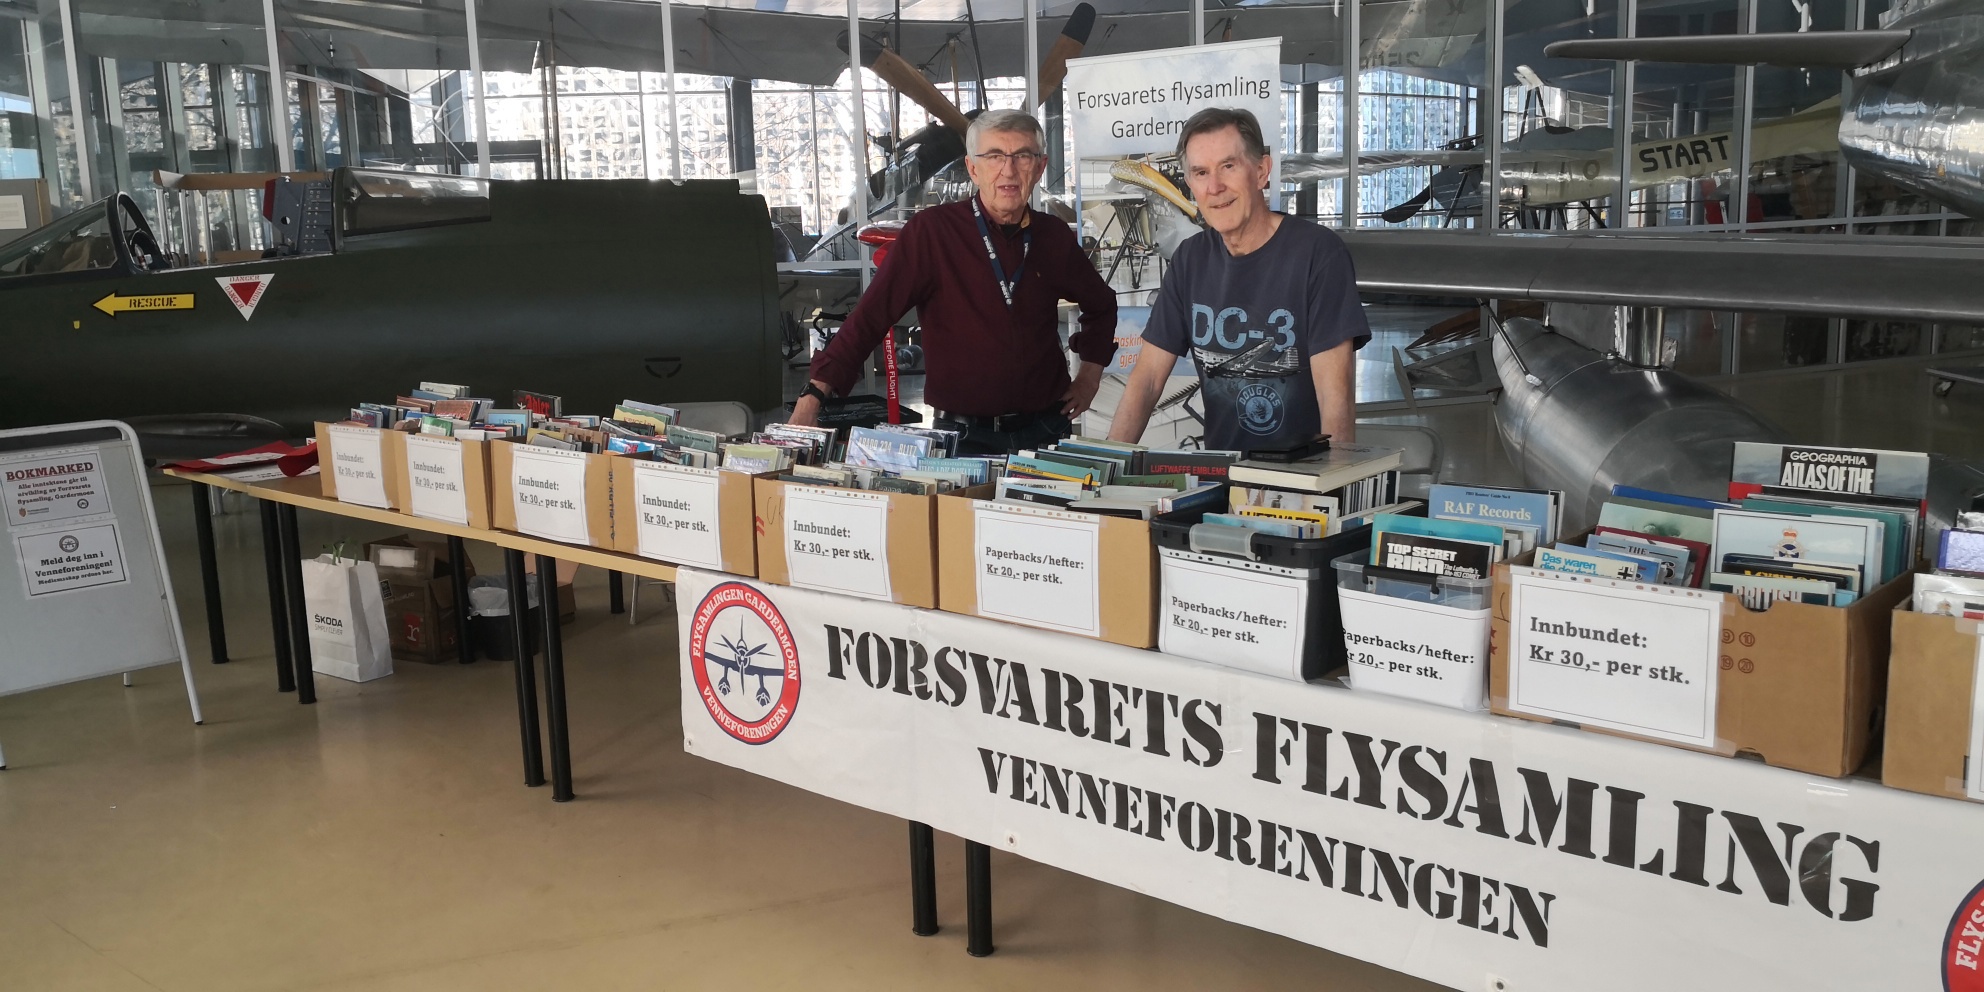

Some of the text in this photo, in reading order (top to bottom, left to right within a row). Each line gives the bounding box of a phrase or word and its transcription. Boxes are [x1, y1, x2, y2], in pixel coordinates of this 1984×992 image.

[1077, 76, 1270, 109] Forsvarets flysamling
[1111, 117, 1188, 138] Garderm
[1639, 135, 1728, 173] START
[129, 297, 177, 308] RESCUE
[224, 285, 244, 310] DANGER
[1192, 303, 1296, 351] DC-3
[885, 340, 894, 370] BEFORE
[1239, 385, 1281, 408] DOUGLAS
[336, 452, 364, 463] Innbundet:
[880, 440, 892, 453] 234
[898, 444, 917, 457] BLITZ
[5, 462, 94, 481] BOKMARKED
[338, 466, 344, 475] Kr
[355, 470, 364, 479] per
[365, 470, 376, 479] stk.
[413, 461, 445, 474] Innbundet:
[1150, 465, 1227, 476] LUFTWAFFE EMBLEMS
[1780, 461, 1874, 494] ATLAS OF THE
[58, 484, 91, 492] Forsvarets
[415, 476, 422, 486] Kr
[434, 482, 445, 491] per
[446, 482, 458, 492] stk.
[518, 476, 559, 491] Innbundet:
[55, 490, 95, 500] Gardermoen
[519, 493, 576, 510] Kr 30,- per stk.
[642, 495, 691, 511] Innbundet:
[1444, 500, 1531, 521] RAF Records
[644, 512, 709, 532] Kr 30,- per stk.
[793, 520, 851, 538] Innbundet:
[40, 556, 64, 566] Meld
[66, 555, 82, 563] deg
[794, 540, 875, 561] Kr 30,- per stk.
[985, 546, 1084, 570] Paperbacks/hefter:
[1387, 542, 1457, 562] TOP SECRET
[1628, 546, 1647, 555] THE
[35, 560, 113, 577] Venneforeningen!
[1542, 552, 1596, 570] Das waren
[986, 564, 1063, 585] Kr 20,- per stk.
[314, 614, 343, 628] ŠKODA
[1172, 596, 1287, 629] Paperbacks/hefter:
[314, 624, 343, 635] SIMPLY CLEVER
[693, 589, 797, 681] FLYSAMLINGEN GARDERMOEN
[1173, 614, 1259, 644] Kr 20,- per stk.
[1530, 617, 1648, 649] Innbundet:
[1358, 652, 1384, 669] 20,-
[1388, 660, 1412, 674] per
[1416, 665, 1443, 681] stk.
[1529, 644, 1690, 685] Kr 30,- per stk.
[704, 685, 789, 739] VENNEFORENINGEN
[823, 624, 1881, 922] FORSVARETS FLYSAMLING
[977, 747, 1556, 948] VENNEFORENINGEN
[1955, 899, 1984, 971] FLYS
